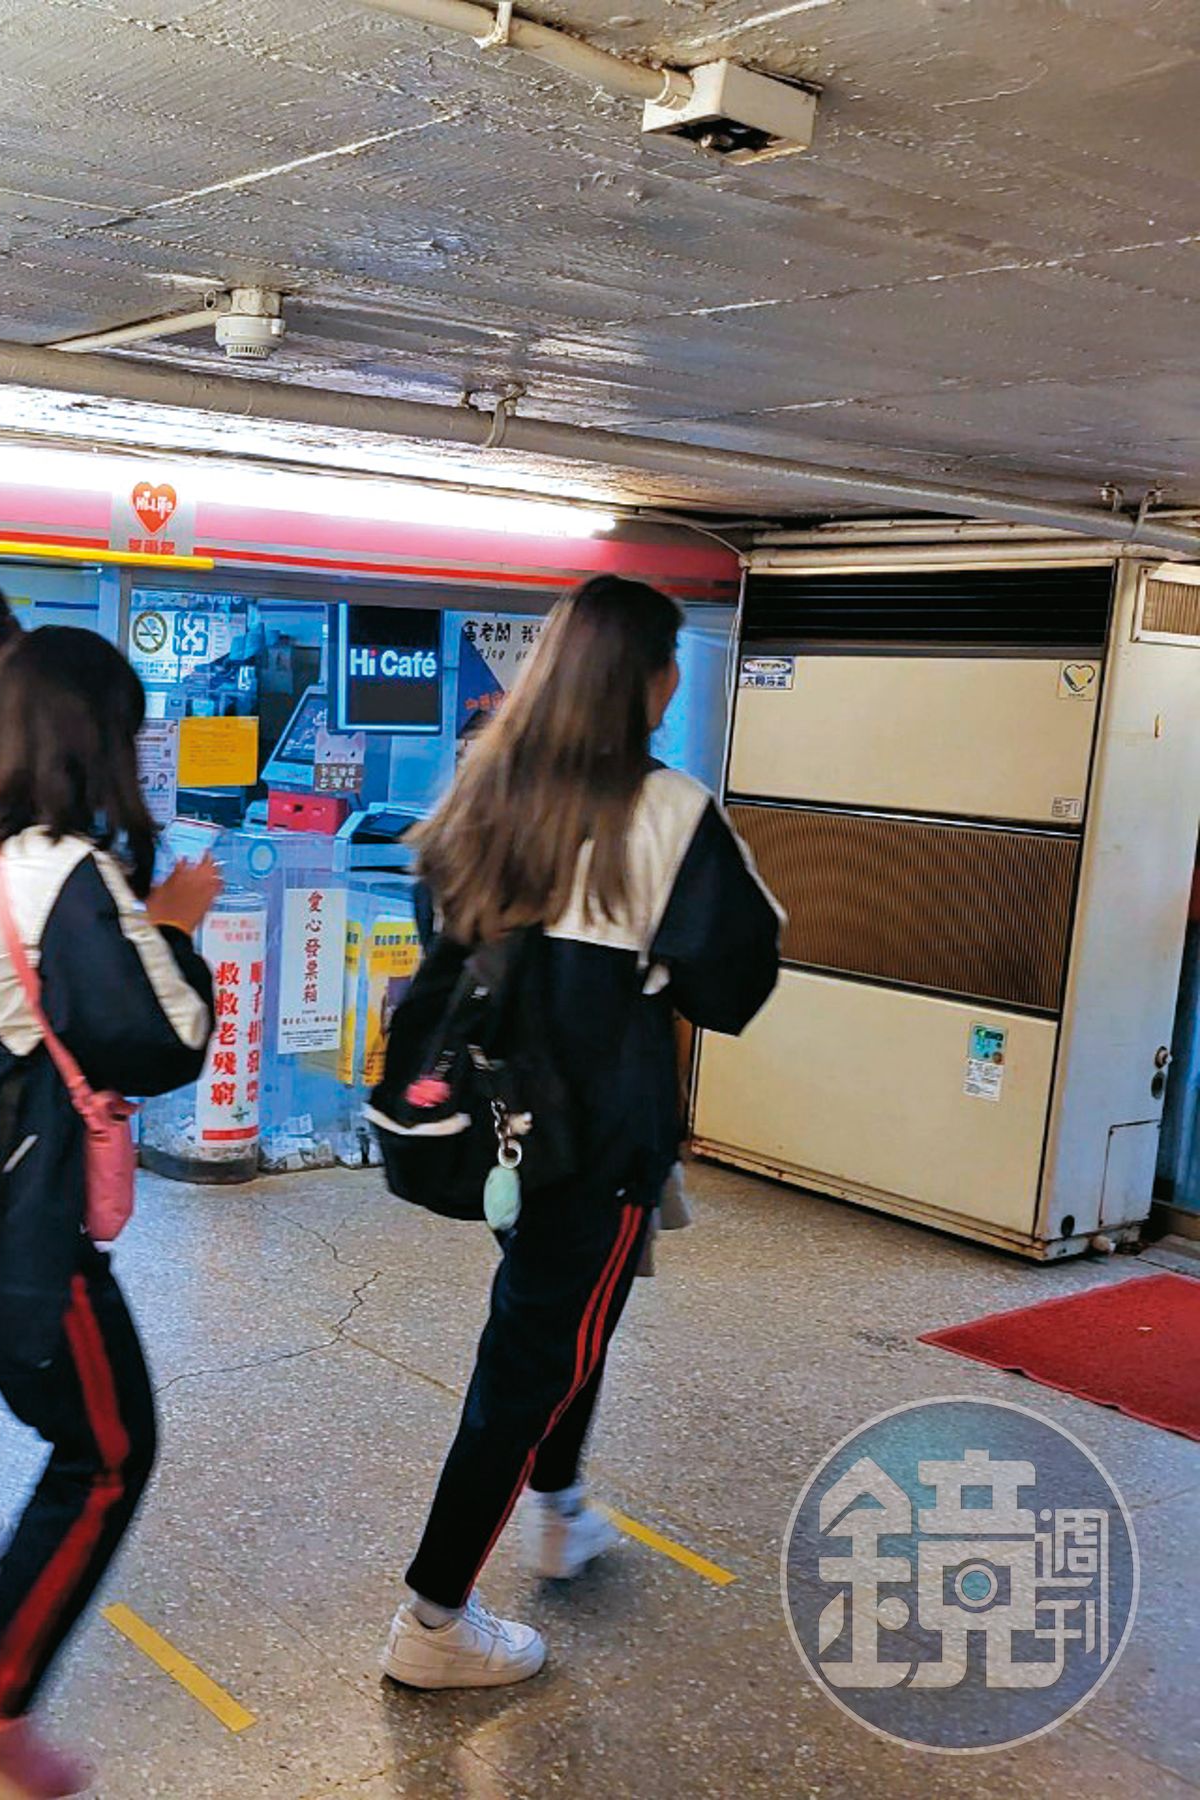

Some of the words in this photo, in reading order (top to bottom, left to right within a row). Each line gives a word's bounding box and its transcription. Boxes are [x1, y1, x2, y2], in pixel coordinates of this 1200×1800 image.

[350, 648, 376, 676] Hi
[380, 650, 438, 678] Café
[303, 890, 324, 1005] 愛心發票箱
